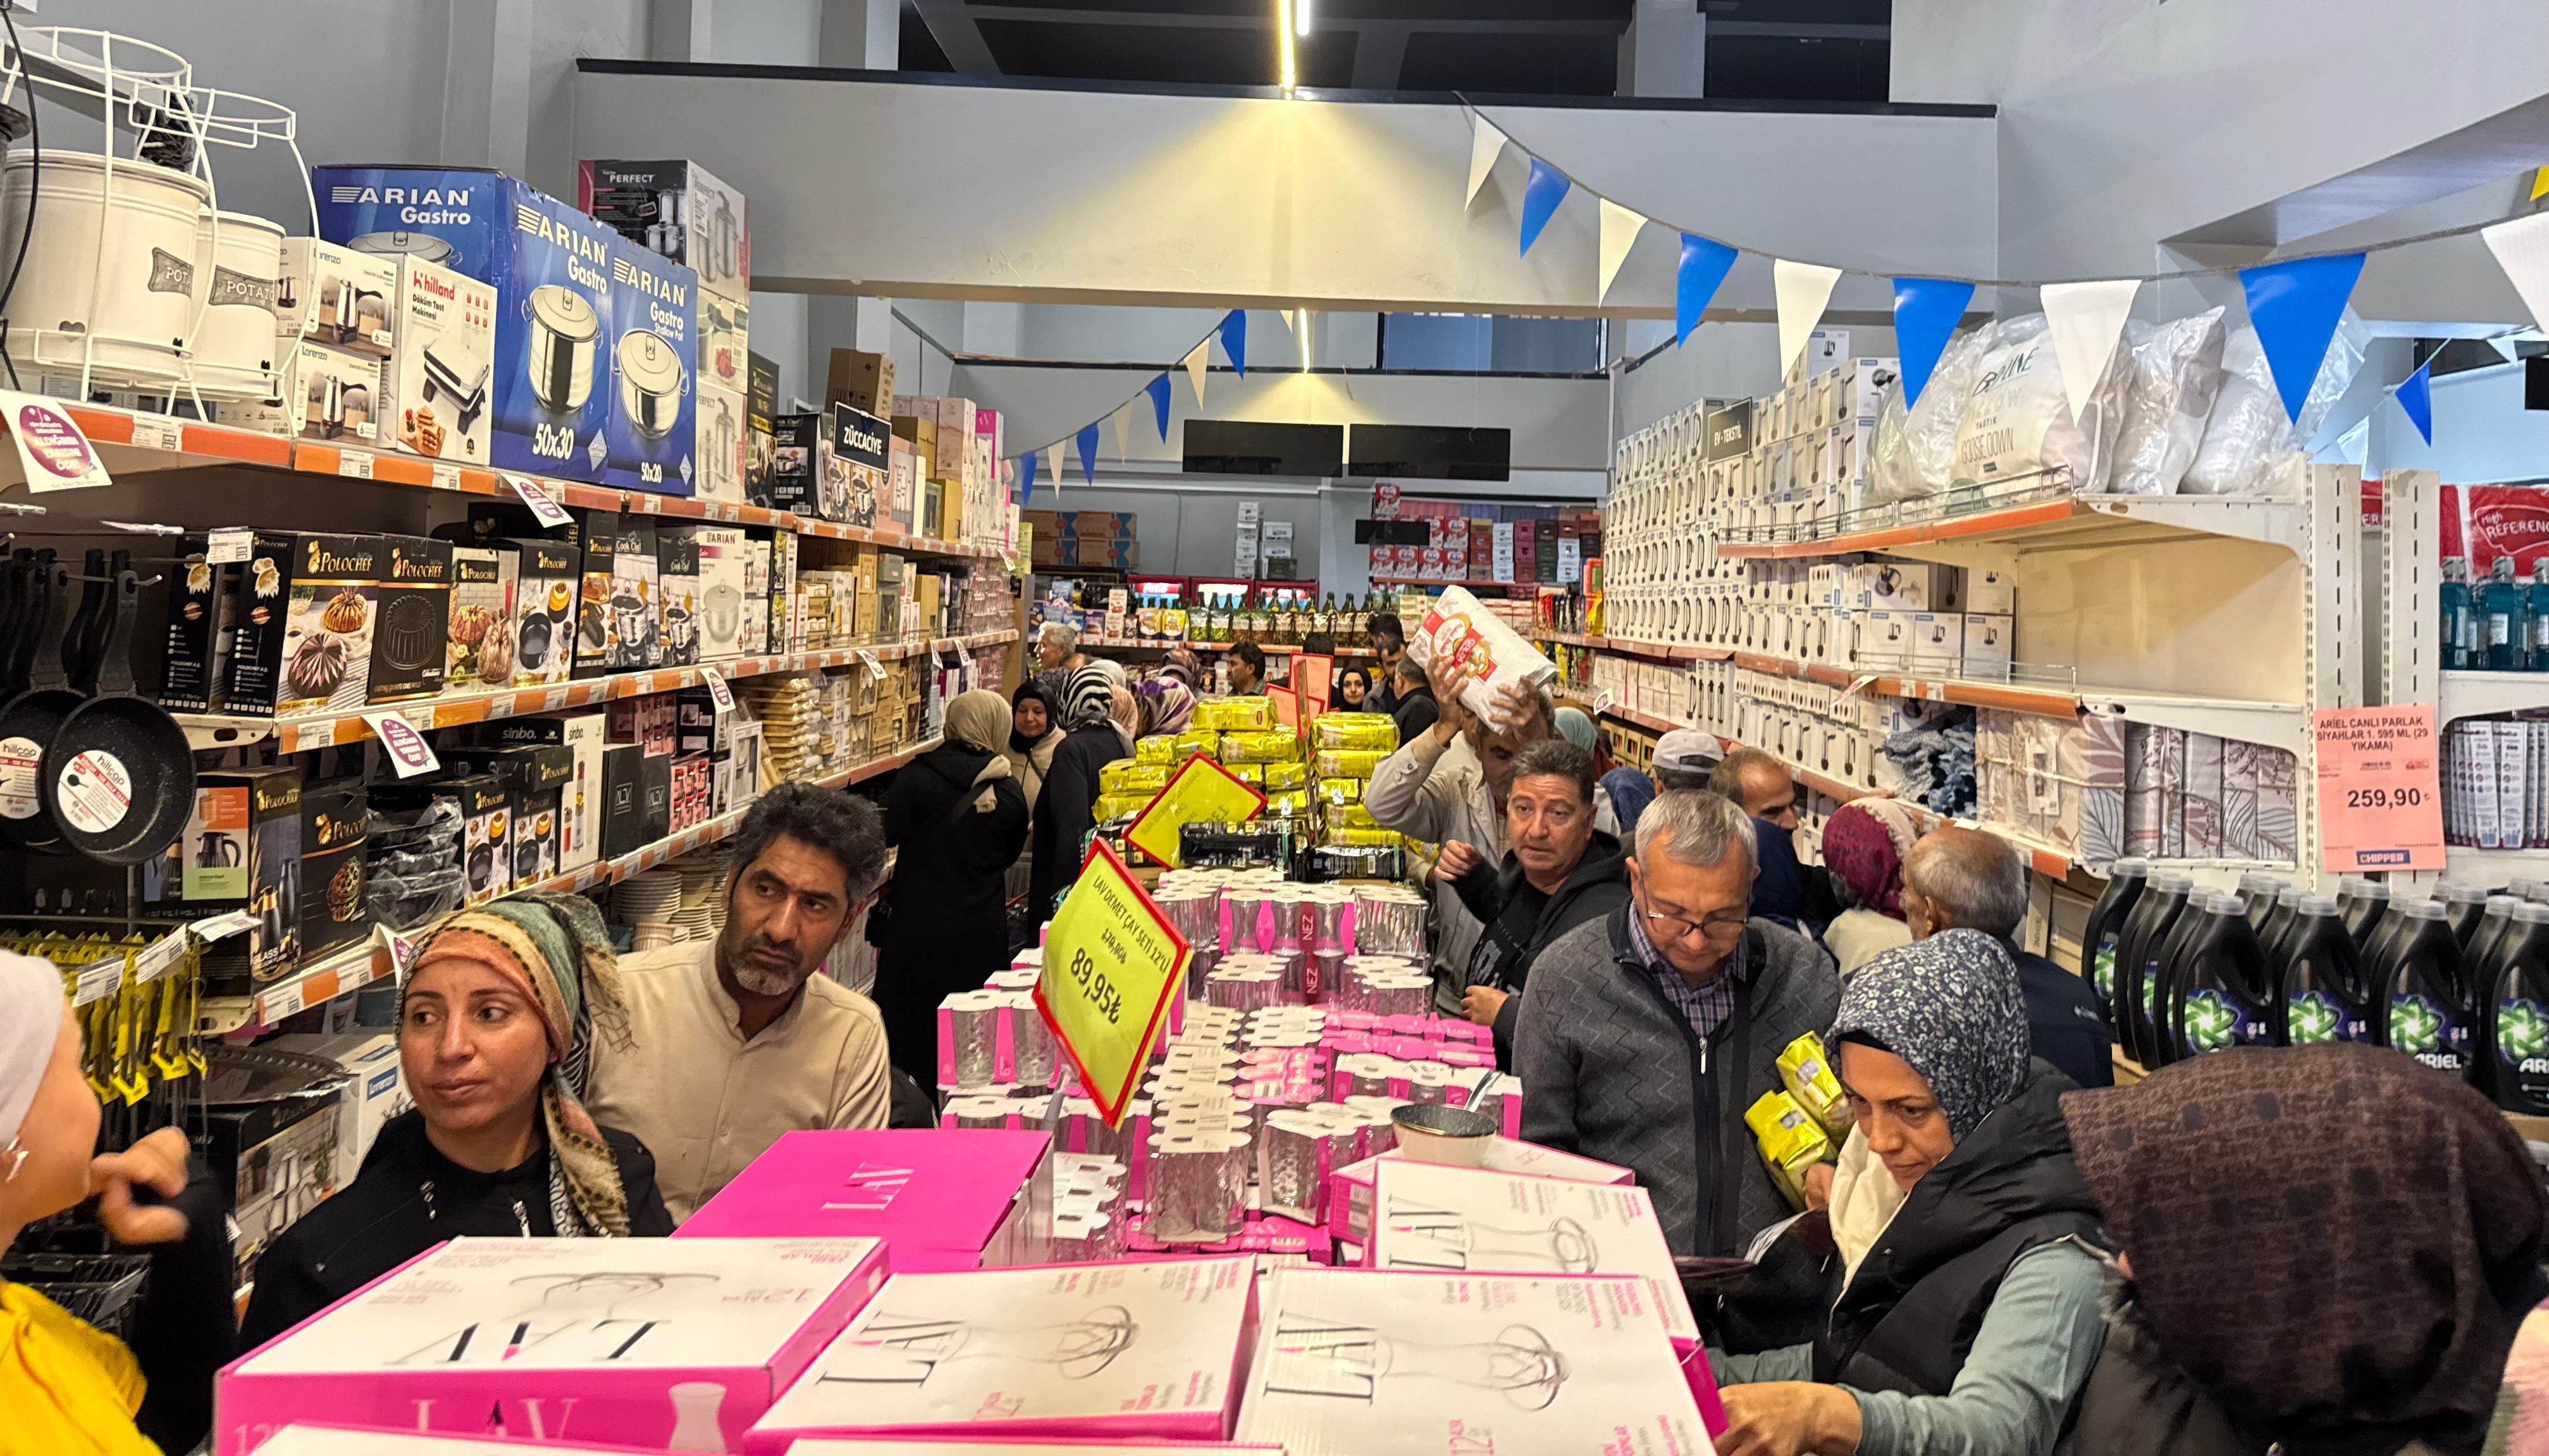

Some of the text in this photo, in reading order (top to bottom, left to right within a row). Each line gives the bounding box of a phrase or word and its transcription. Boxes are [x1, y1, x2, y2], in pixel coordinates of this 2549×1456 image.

[610, 174, 655, 183] PERFECT
[357, 188, 470, 206] ARIAN
[400, 207, 471, 225] Gastro
[538, 215, 607, 268] ARIAN
[307, 247, 341, 265] Lrenzo
[568, 255, 607, 295] Gastro
[424, 277, 455, 300] hilland
[627, 266, 685, 307] ARIAN
[412, 293, 431, 309] Döküm
[412, 304, 437, 321] Makinesi
[650, 302, 684, 330] Gastro
[654, 323, 684, 342] Shallow Pot
[302, 345, 328, 361] Lorenzo
[532, 422, 574, 460] 50x30
[843, 424, 882, 457] ZÜCCACİYE
[1714, 431, 1721, 447] EV
[1723, 419, 1743, 446] TEKSTİL
[1961, 426, 2014, 465] GOOSE DOWN
[641, 460, 662, 484] 50x20
[2481, 512, 2503, 525] High
[615, 540, 630, 552] Cook
[711, 531, 736, 545] ARIAN
[320, 552, 373, 572] POLOCHEF
[401, 559, 443, 577] POLOCHEF
[543, 557, 567, 569] POLOCHEF
[670, 562, 681, 572] Cook
[468, 569, 496, 580] POLOCHEF
[2320, 716, 2424, 729] ARİEL CANLI PARLAK
[2316, 730, 2365, 741] SİYAHLAR
[2377, 729, 2395, 740] 595
[2396, 729, 2412, 739] ML
[2413, 727, 2429, 740] (29
[2350, 741, 2393, 752] YIKAMA)
[97, 755, 125, 786] hillcap
[545, 763, 570, 779] POLOCHEF
[264, 792, 299, 810] POLOCHEF
[481, 793, 505, 809] POLOCHEF
[2347, 787, 2421, 810] 259,90
[2359, 853, 2405, 864] CHIPPER
[1093, 875, 1171, 974] LAV DEMET ÇAY SETİ 12'Lİ
[1302, 914, 1314, 941] NEZ
[254, 947, 279, 965] GLASS
[1071, 947, 1121, 1024] 89,95₺
[1306, 967, 1318, 994] NEZ
[820, 1161, 916, 1211] LAV
[1388, 1193, 1467, 1270] LAV
[815, 1309, 966, 1387] LAV
[1263, 1309, 1378, 1405] LAV
